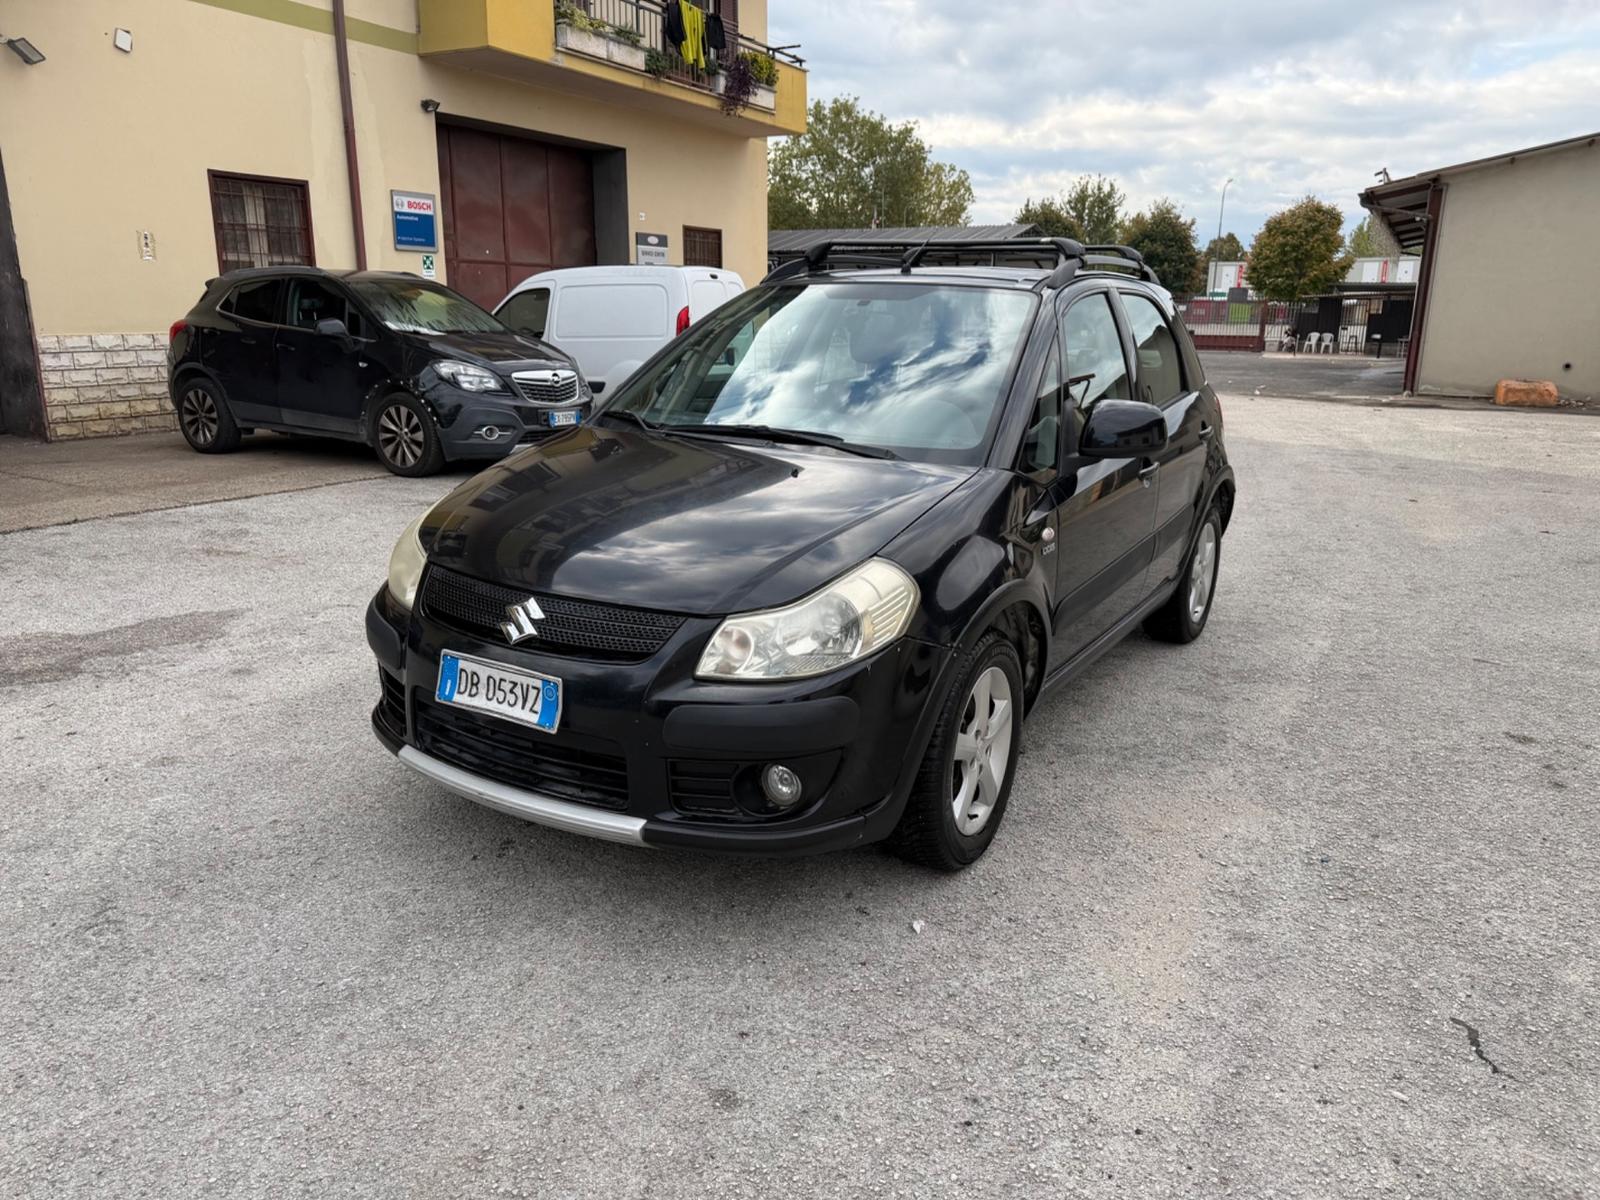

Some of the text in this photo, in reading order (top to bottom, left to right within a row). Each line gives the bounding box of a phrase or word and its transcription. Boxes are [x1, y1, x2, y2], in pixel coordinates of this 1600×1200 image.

[407, 200, 432, 211] BOSCH
[457, 668, 541, 714] DB 053VZ
